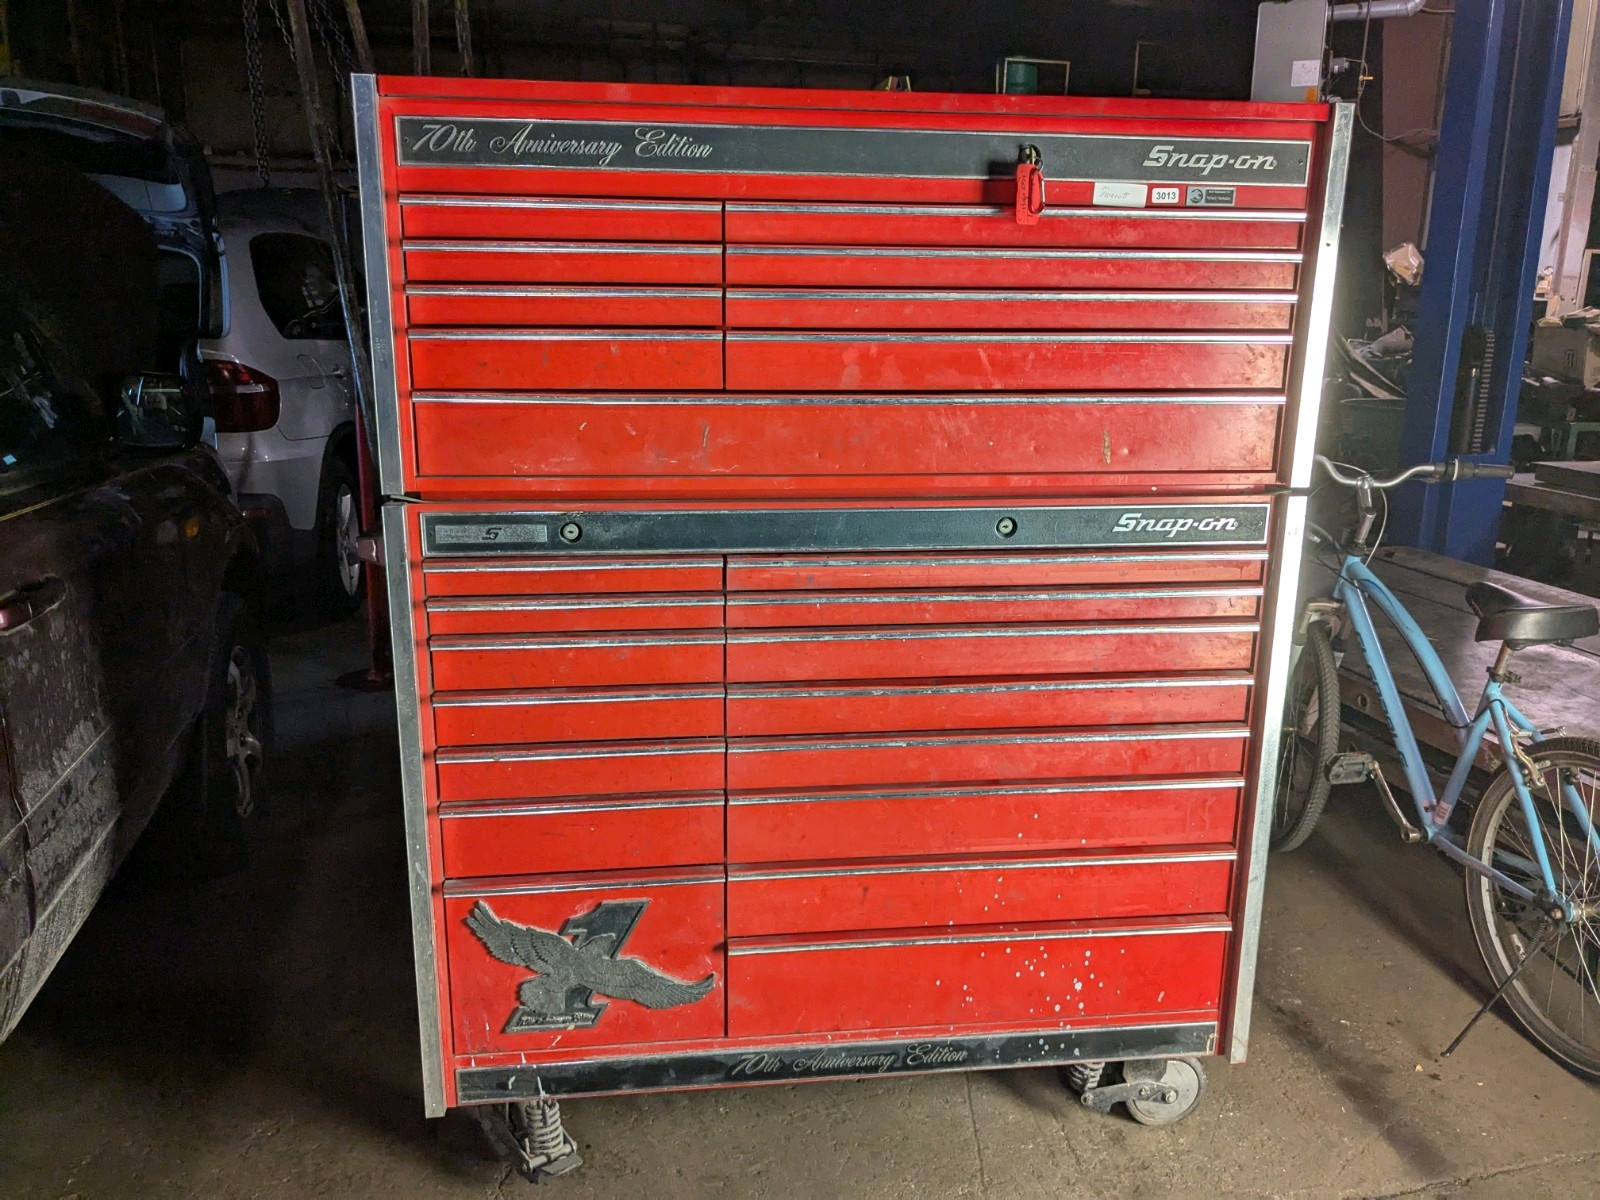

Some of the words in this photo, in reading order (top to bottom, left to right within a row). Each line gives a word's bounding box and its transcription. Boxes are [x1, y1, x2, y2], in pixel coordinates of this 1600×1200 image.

[411, 123, 477, 152] 70th
[489, 123, 623, 167] Anniversary
[634, 126, 714, 159] Edition
[1142, 145, 1275, 176] Snap-on
[1156, 191, 1176, 200] 3013
[1112, 512, 1236, 538] Snap-on
[731, 1053, 783, 1076] 70th
[792, 1047, 897, 1073] Anniversary
[906, 1043, 969, 1066] Edition
